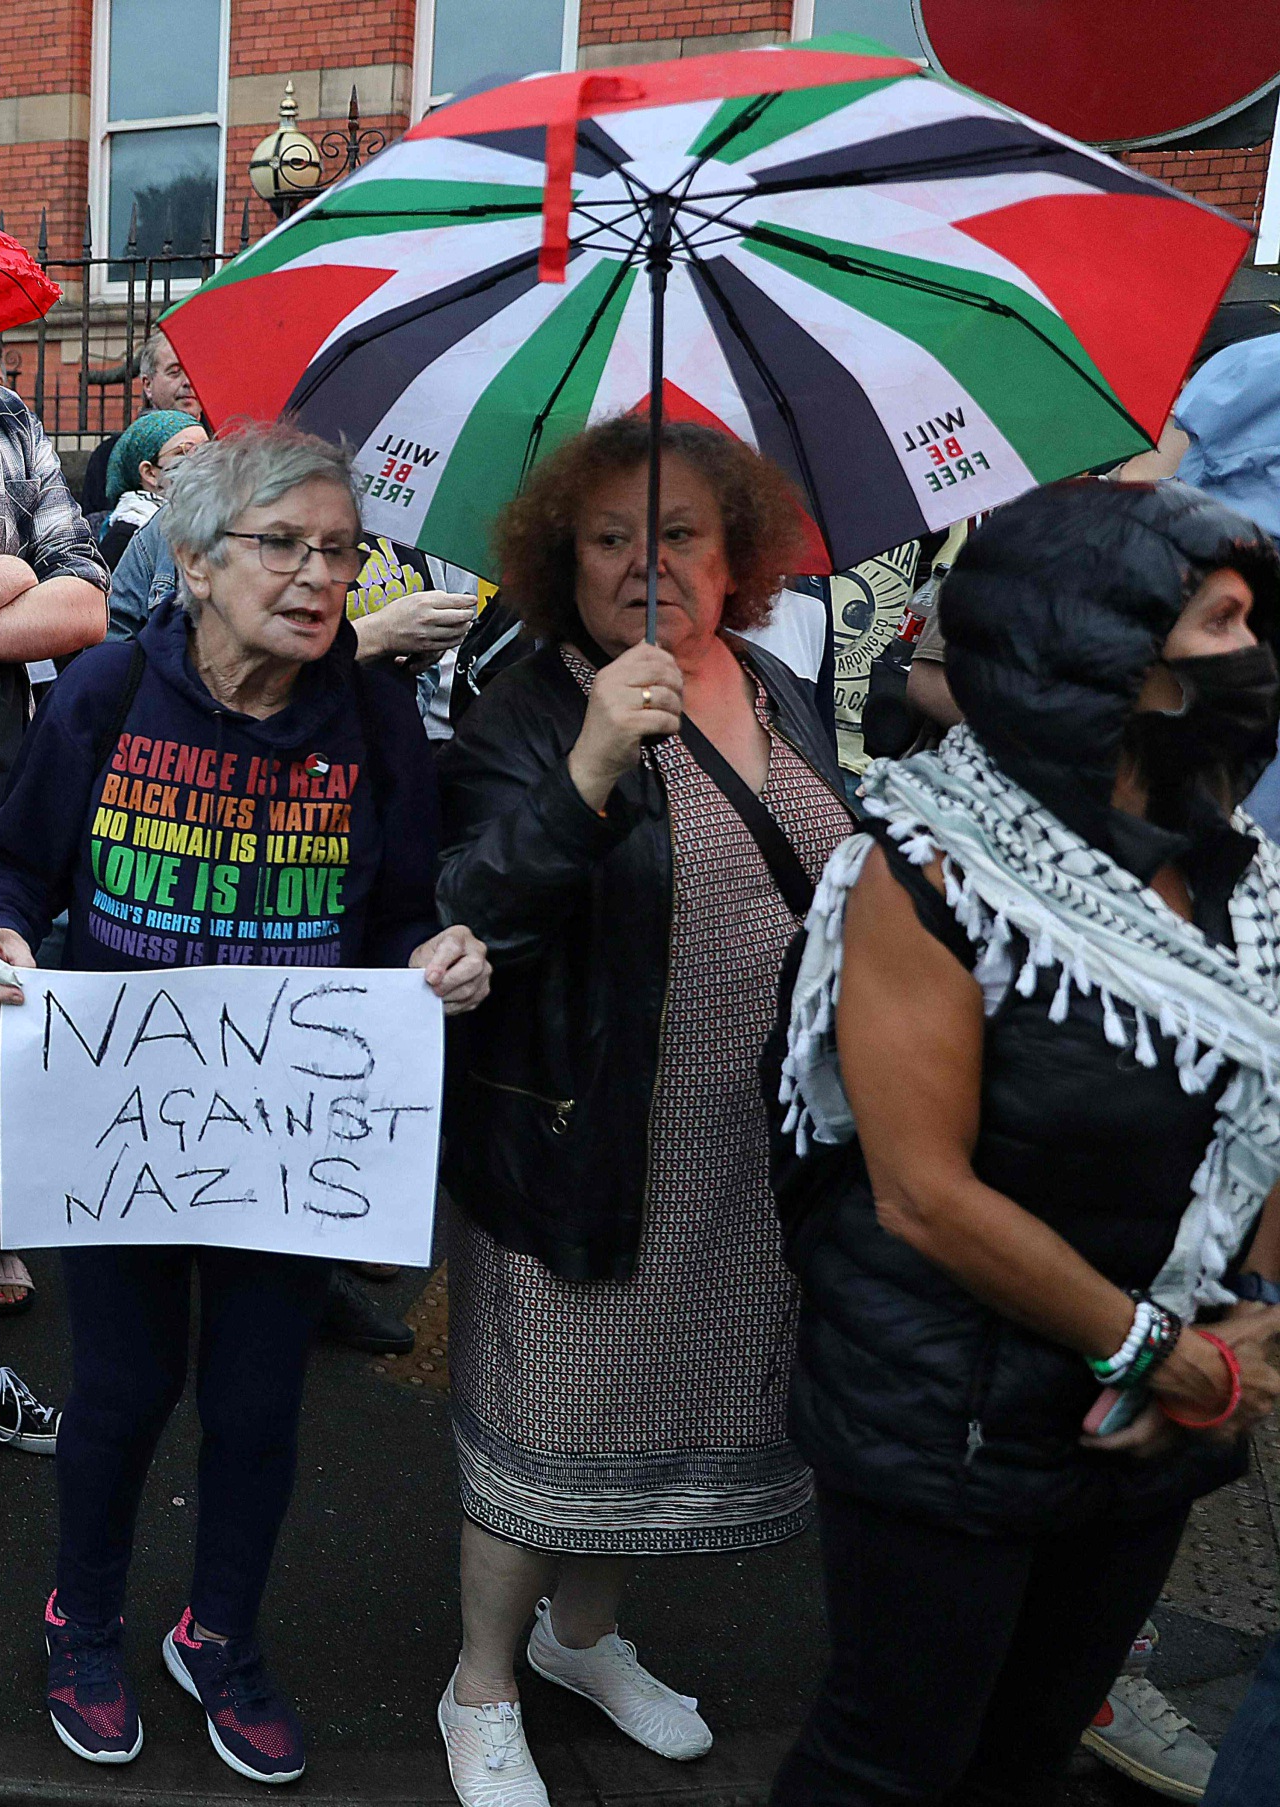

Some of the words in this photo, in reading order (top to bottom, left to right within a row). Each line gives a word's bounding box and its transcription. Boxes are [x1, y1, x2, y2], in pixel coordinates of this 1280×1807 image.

[111, 732, 238, 791] SCIENCE
[246, 756, 281, 796] IS
[100, 773, 180, 818] BLACK
[185, 789, 256, 830] LIVES
[267, 800, 352, 833] MATTER
[92, 806, 128, 841] NO
[132, 815, 223, 859] HUMAN
[229, 832, 258, 863] IS
[265, 834, 350, 865] ILLEGAL
[91, 839, 182, 908] LOVE
[191, 862, 240, 915] IS
[254, 866, 346, 917] LOVE
[88, 911, 177, 966] KINDNESS
[92, 888, 143, 926] WOMEN'S
[145, 909, 202, 935] RIGHTS
[237, 919, 293, 940] HUMAN
[42, 977, 376, 1081] NANS
[65, 1143, 371, 1225] NAZIS
